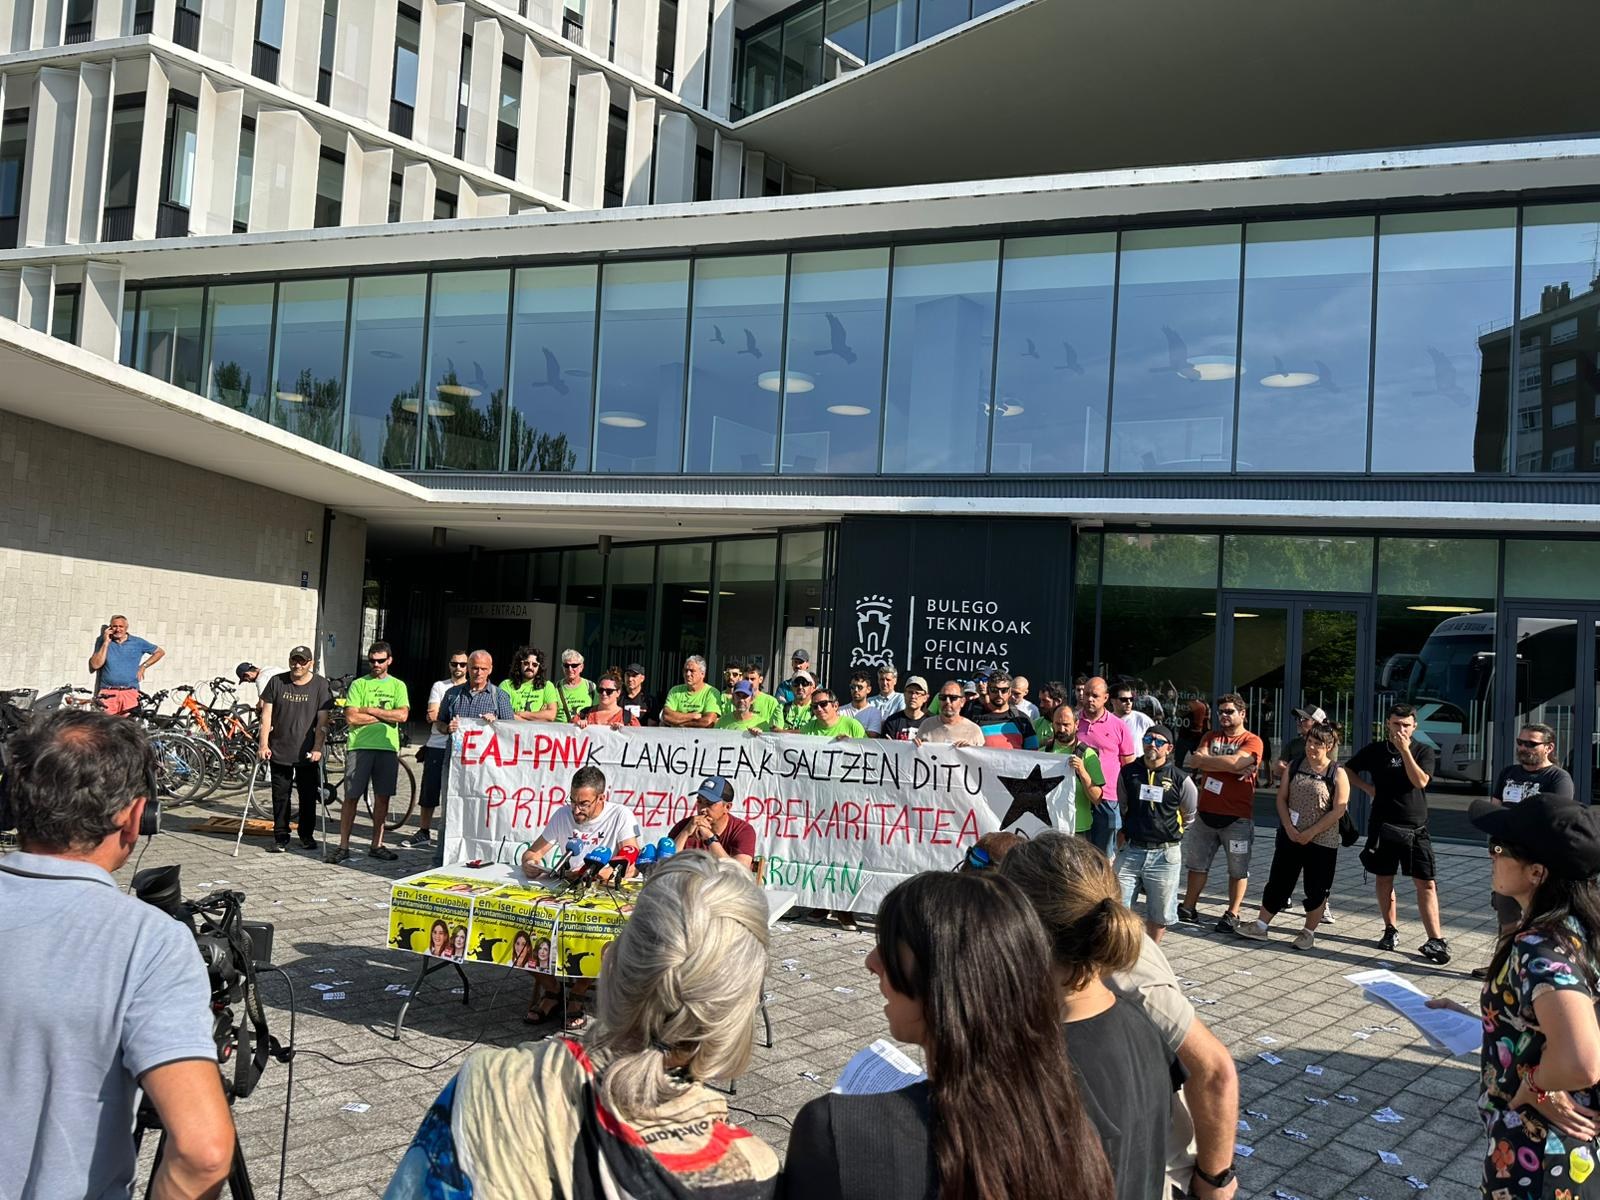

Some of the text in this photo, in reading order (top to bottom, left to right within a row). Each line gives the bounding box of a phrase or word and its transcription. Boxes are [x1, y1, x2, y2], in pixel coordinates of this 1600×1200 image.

[927, 599, 998, 615] BULEGO
[926, 616, 1031, 635] TEKNIKOAK
[924, 639, 1008, 656] OFICINAS
[780, 748, 900, 790] SALTZEN
[473, 908, 516, 921] Ayuntamiento
[559, 922, 602, 933] Ayuntamiento
